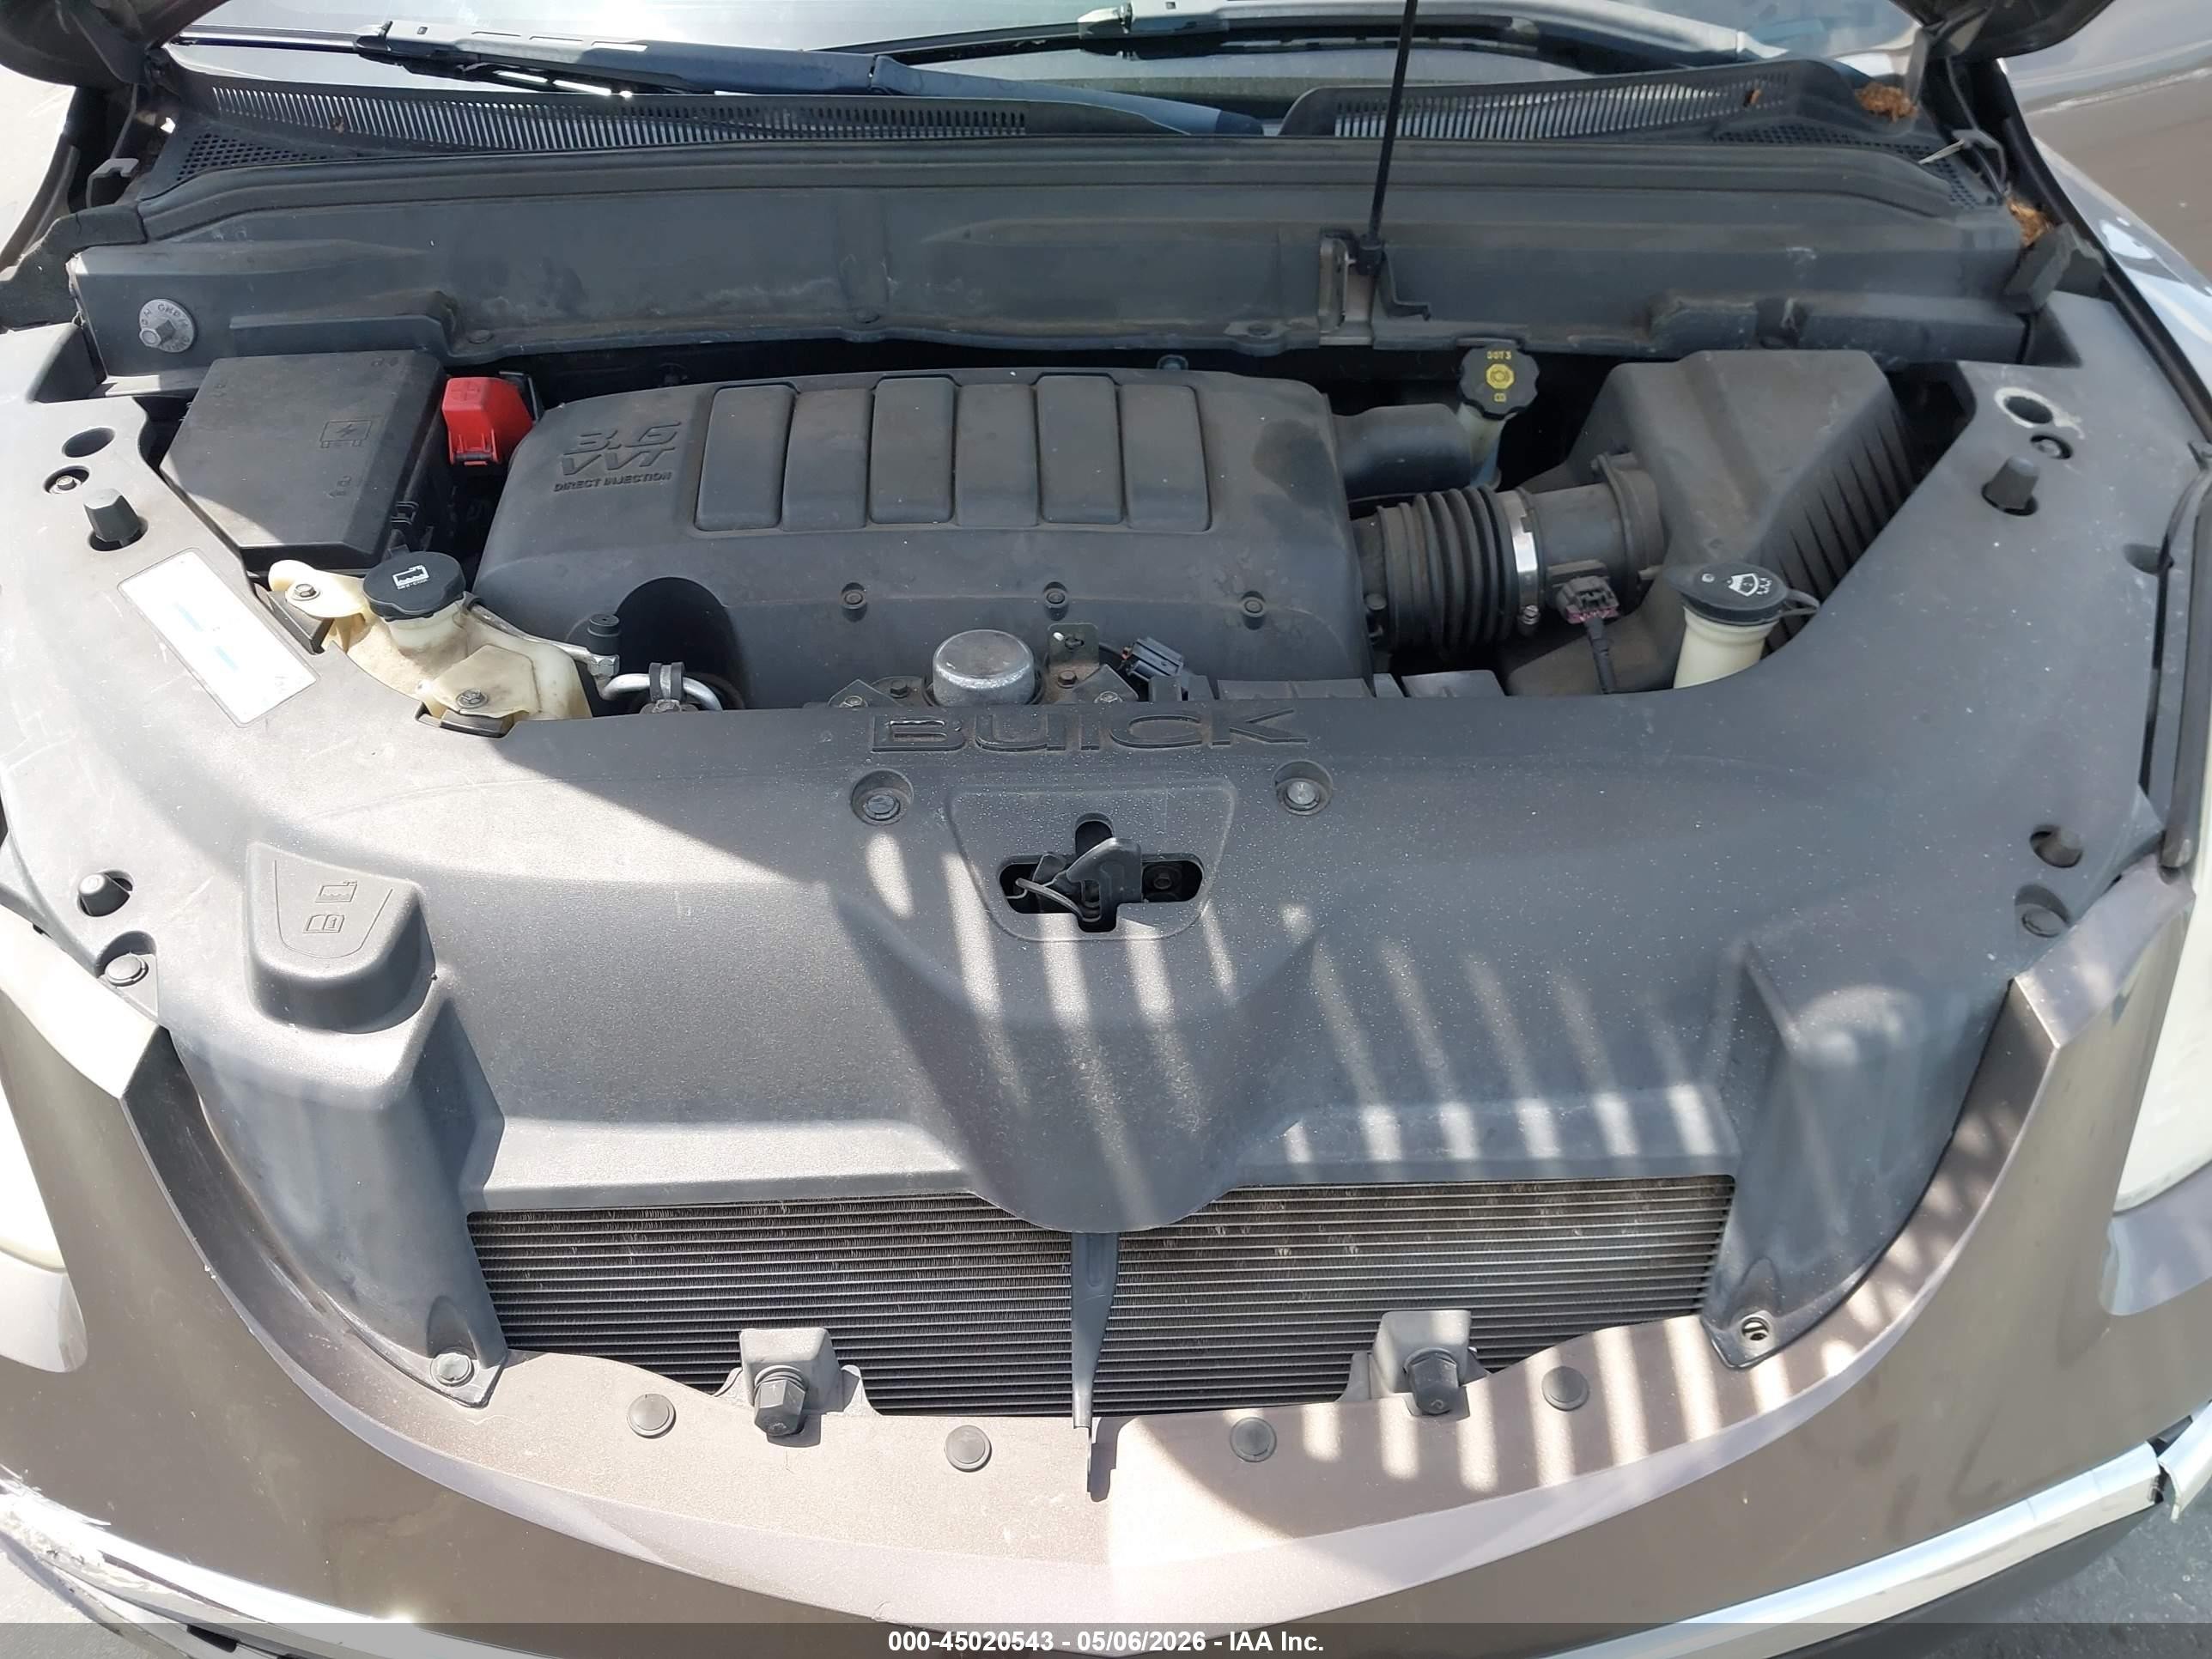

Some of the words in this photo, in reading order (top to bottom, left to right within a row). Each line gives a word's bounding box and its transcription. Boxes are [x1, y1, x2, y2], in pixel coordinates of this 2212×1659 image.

[562, 421, 682, 455] 3.6
[562, 447, 677, 476] VVT
[553, 477, 602, 492] DIRECT
[603, 471, 673, 486] INJECTION
[872, 708, 1308, 752] BUICK
